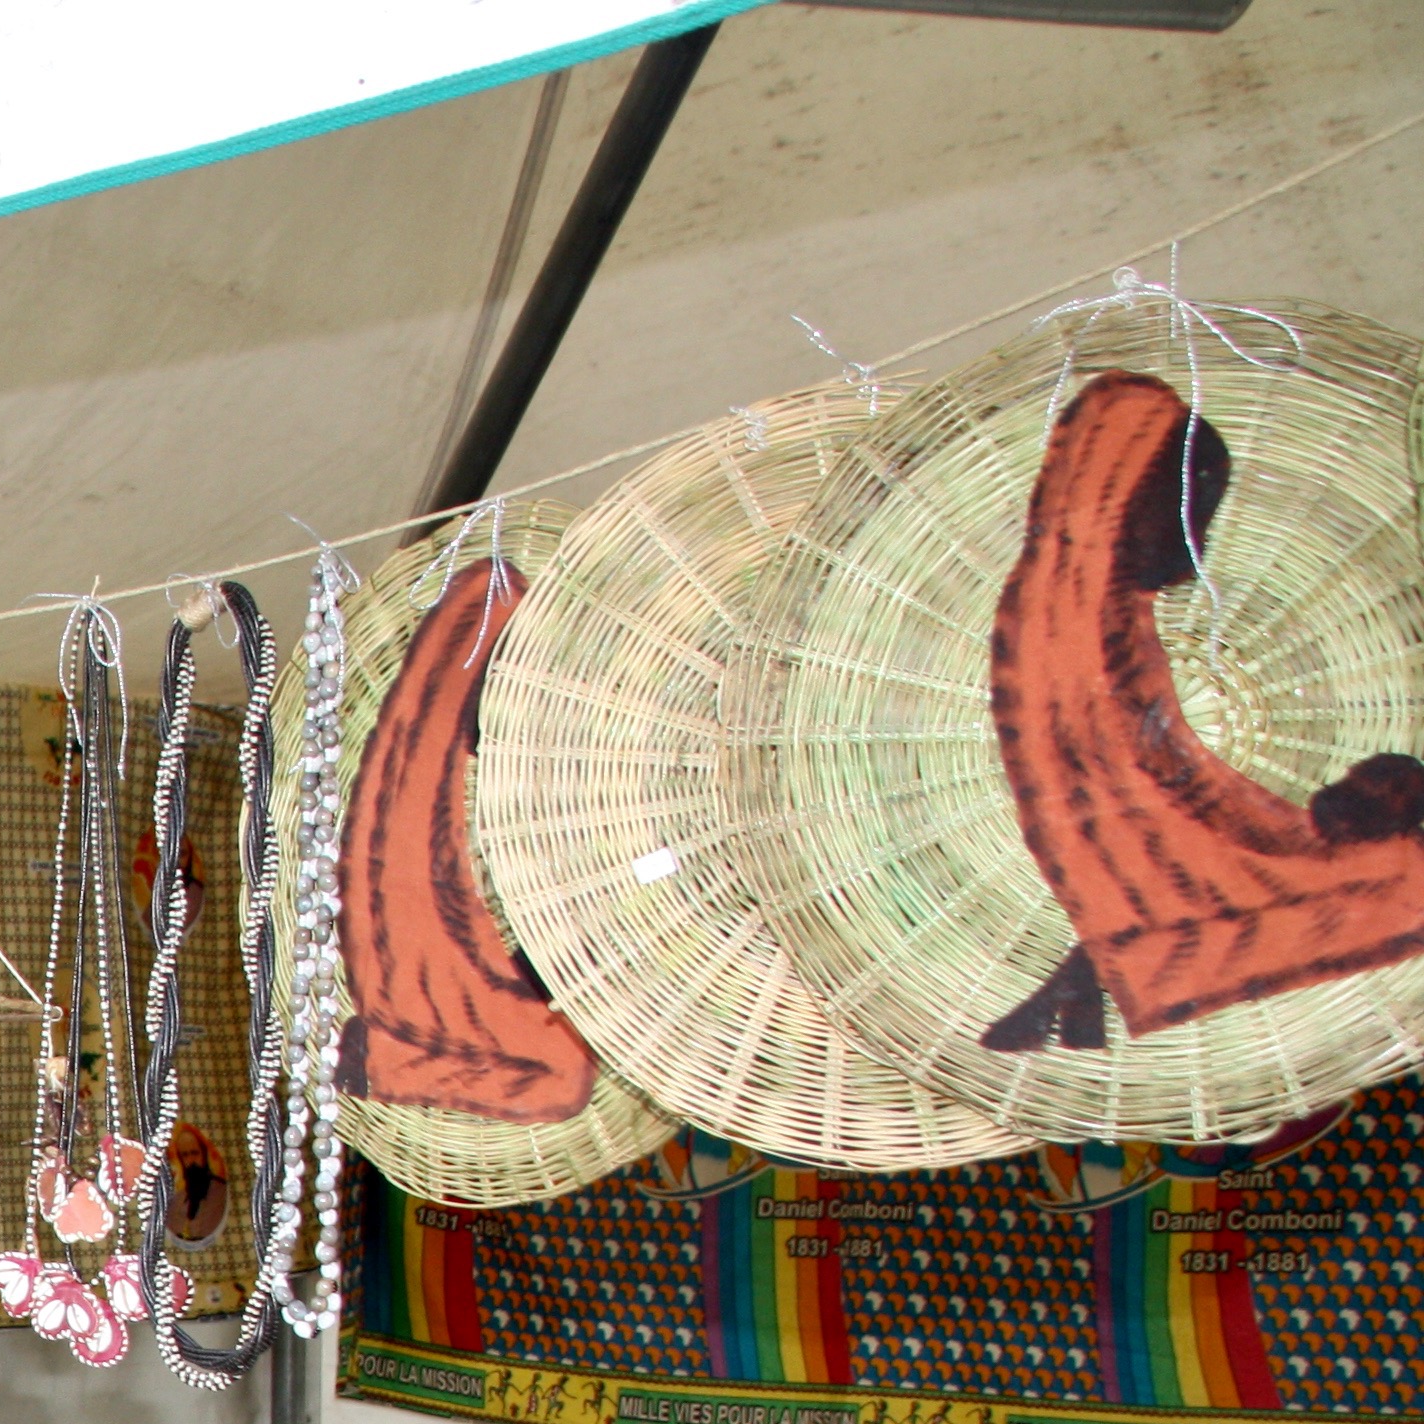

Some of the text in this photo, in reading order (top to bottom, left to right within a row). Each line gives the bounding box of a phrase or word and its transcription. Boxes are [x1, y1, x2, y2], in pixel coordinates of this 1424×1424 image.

[1218, 1169, 1276, 1190] Saint
[417, 1207, 459, 1231] 1831
[757, 1197, 915, 1220] Daniel Comboni
[1152, 1209, 1343, 1231] Daniel Comboni
[787, 1237, 828, 1257] 1831
[1182, 1252, 1229, 1272] 1831
[357, 1353, 482, 1397] POUR LA MISSION
[619, 1395, 670, 1422] MILLE
